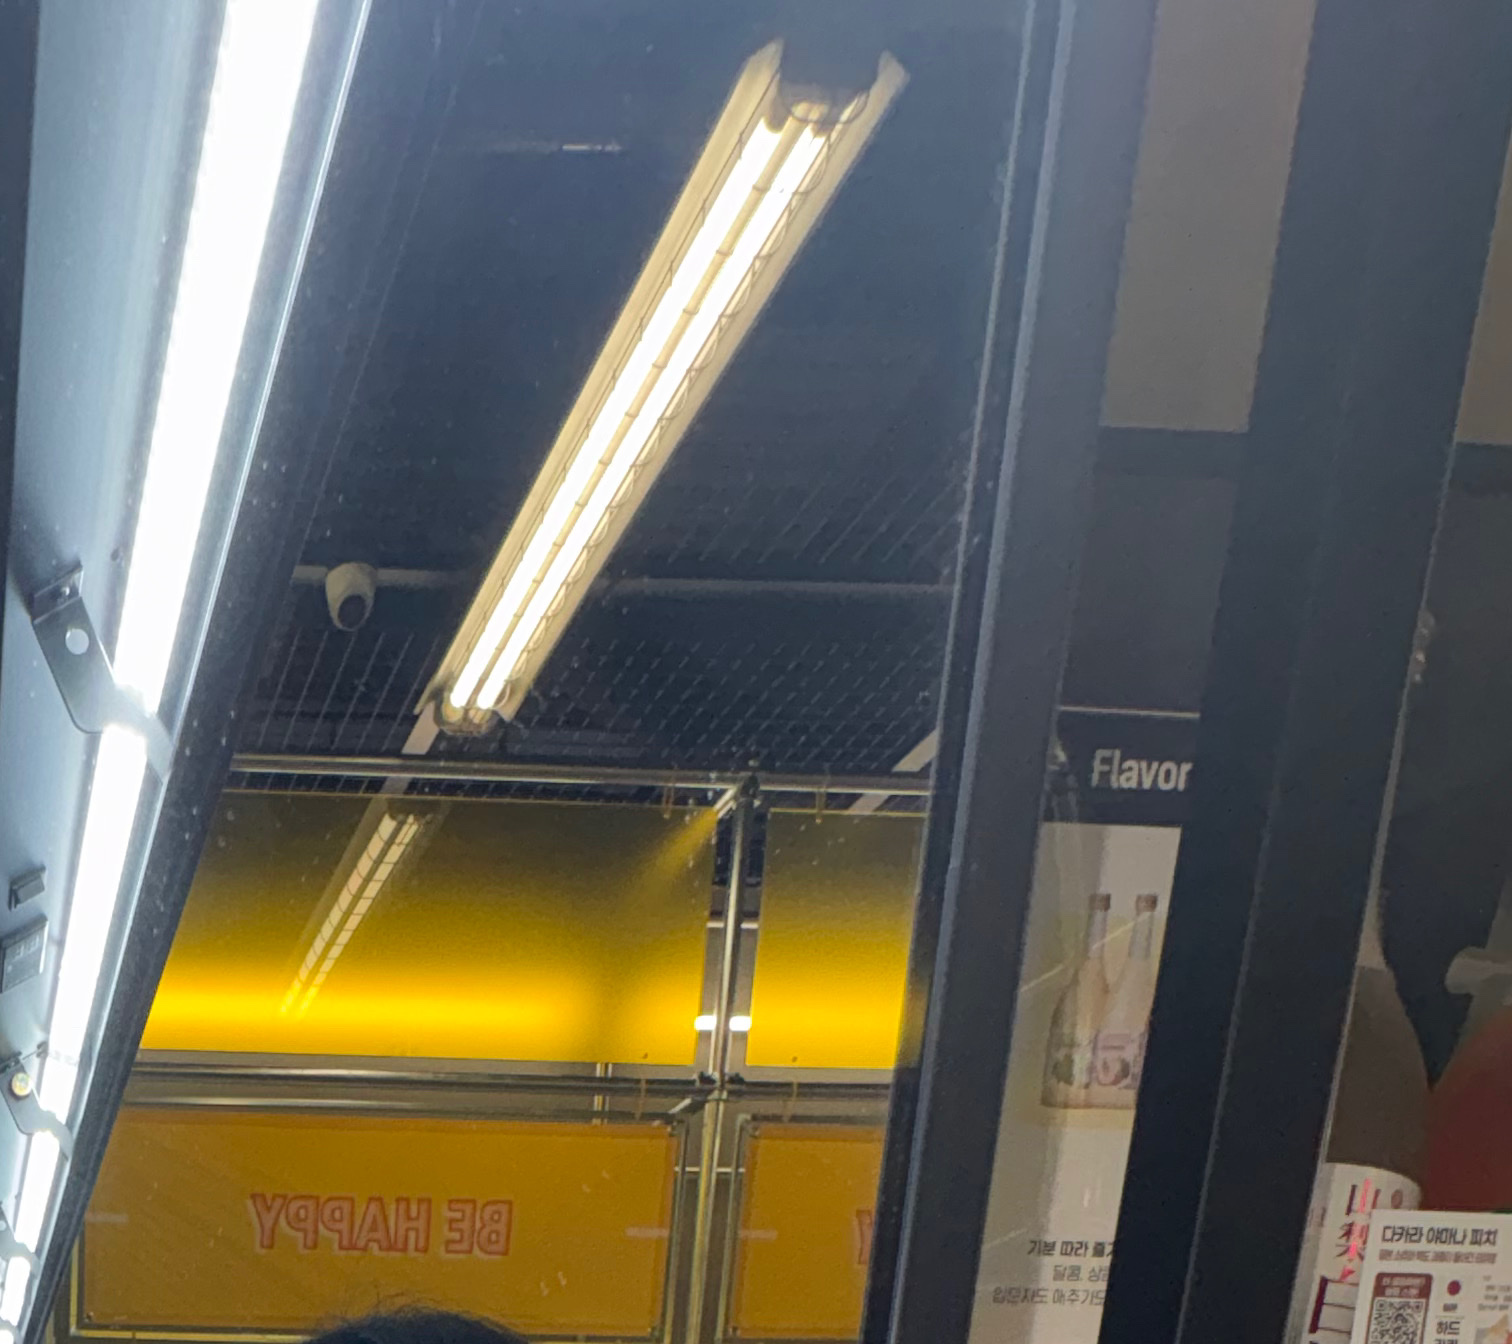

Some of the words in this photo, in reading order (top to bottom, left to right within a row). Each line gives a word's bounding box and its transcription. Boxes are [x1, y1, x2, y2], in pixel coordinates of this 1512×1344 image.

[1090, 749, 1193, 792] Flavor
[1027, 1241, 1056, 1257] 기분
[1061, 1241, 1089, 1257] 따라
